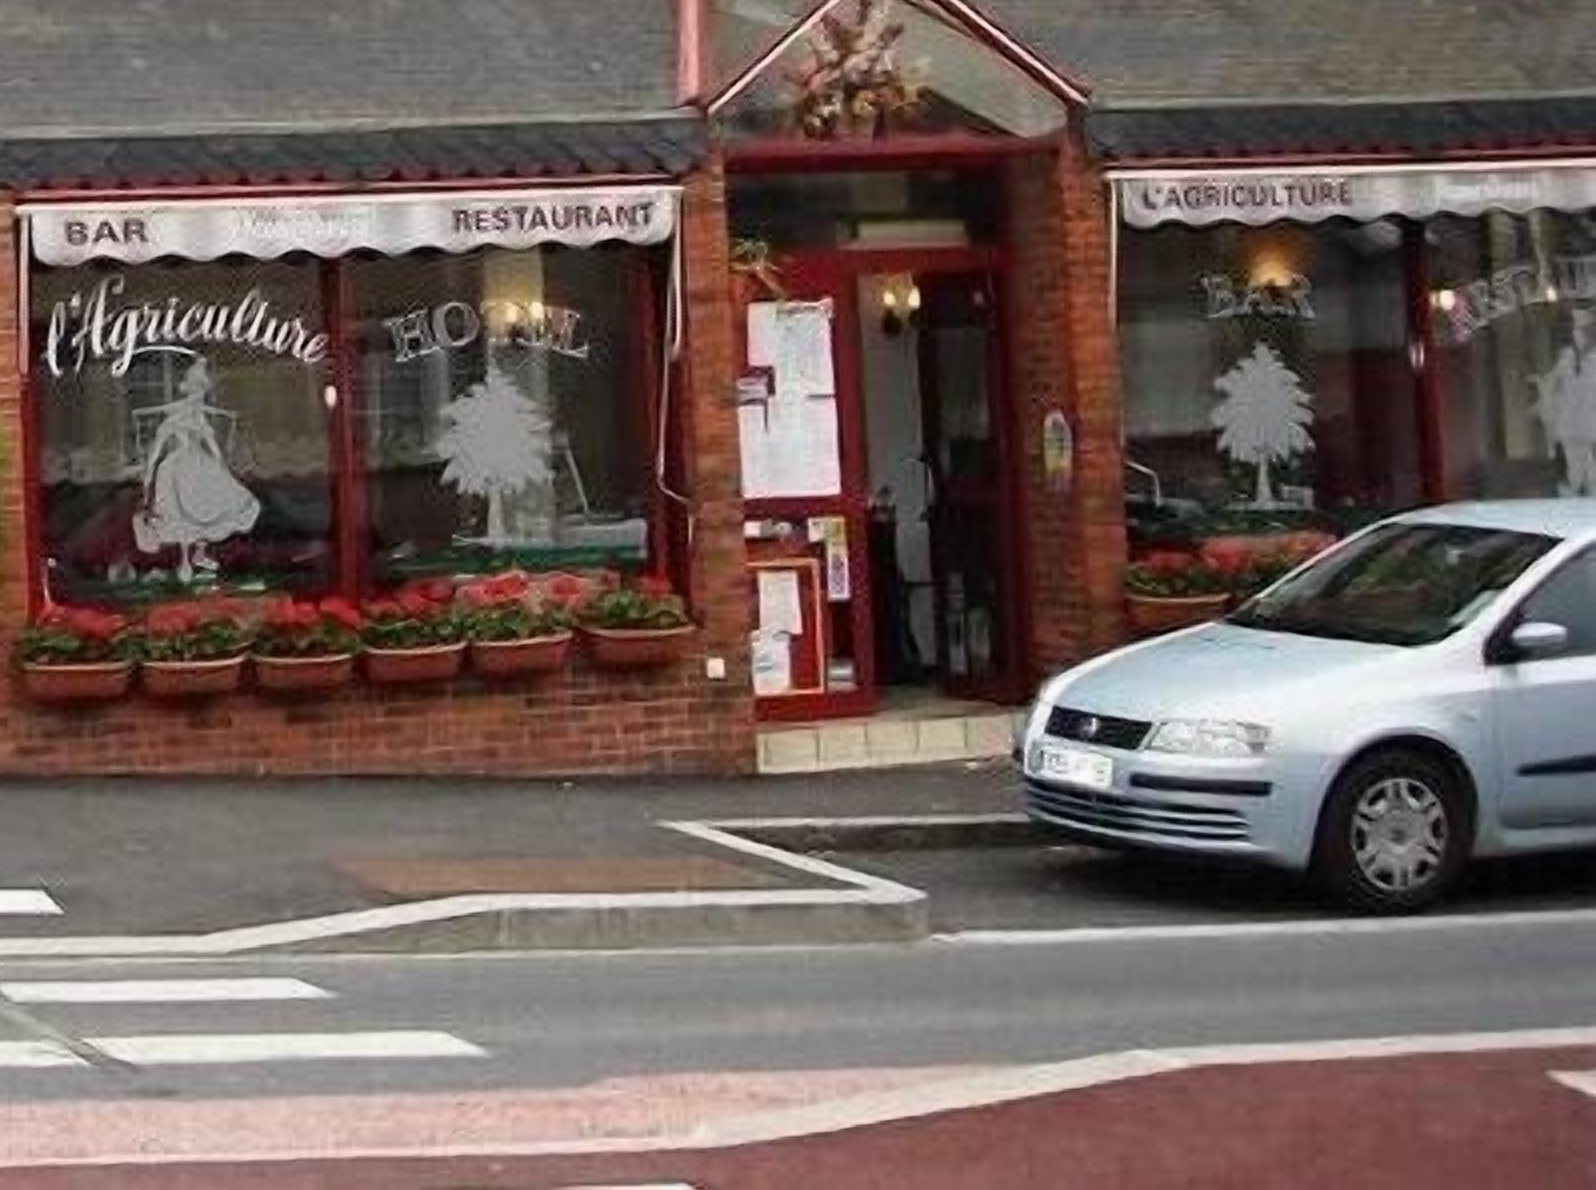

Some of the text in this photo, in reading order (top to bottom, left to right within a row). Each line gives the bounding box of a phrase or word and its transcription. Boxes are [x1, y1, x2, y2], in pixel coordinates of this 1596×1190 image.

[1142, 182, 1353, 210] L'AGRICULTURE
[455, 201, 654, 231] RESTAURANT
[64, 217, 149, 246] BAR
[45, 274, 329, 378] l'Agriculture
